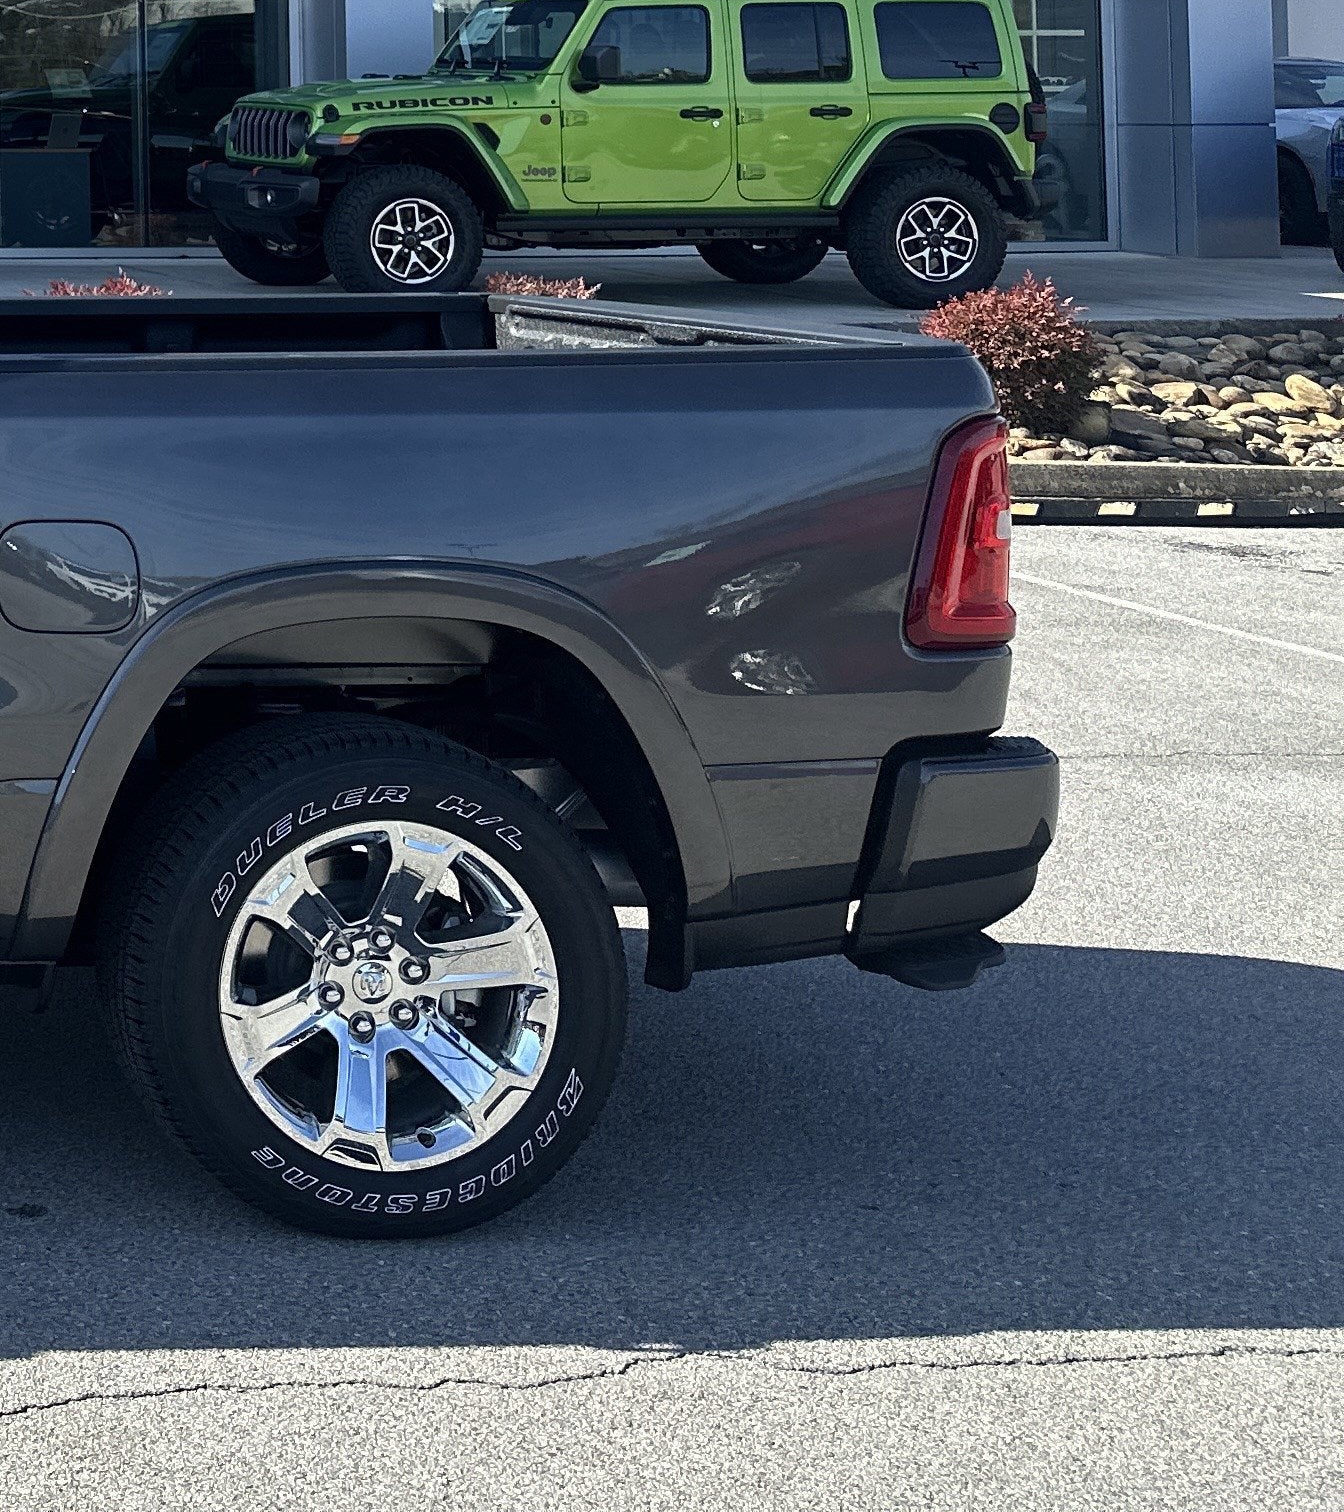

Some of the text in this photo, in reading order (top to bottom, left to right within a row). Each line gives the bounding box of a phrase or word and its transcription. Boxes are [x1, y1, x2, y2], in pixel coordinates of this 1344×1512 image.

[351, 95, 494, 112] RUBICON
[522, 164, 557, 178] Jeep
[210, 784, 411, 918] DUELER
[250, 1067, 585, 1216] BRIDGESTONE
